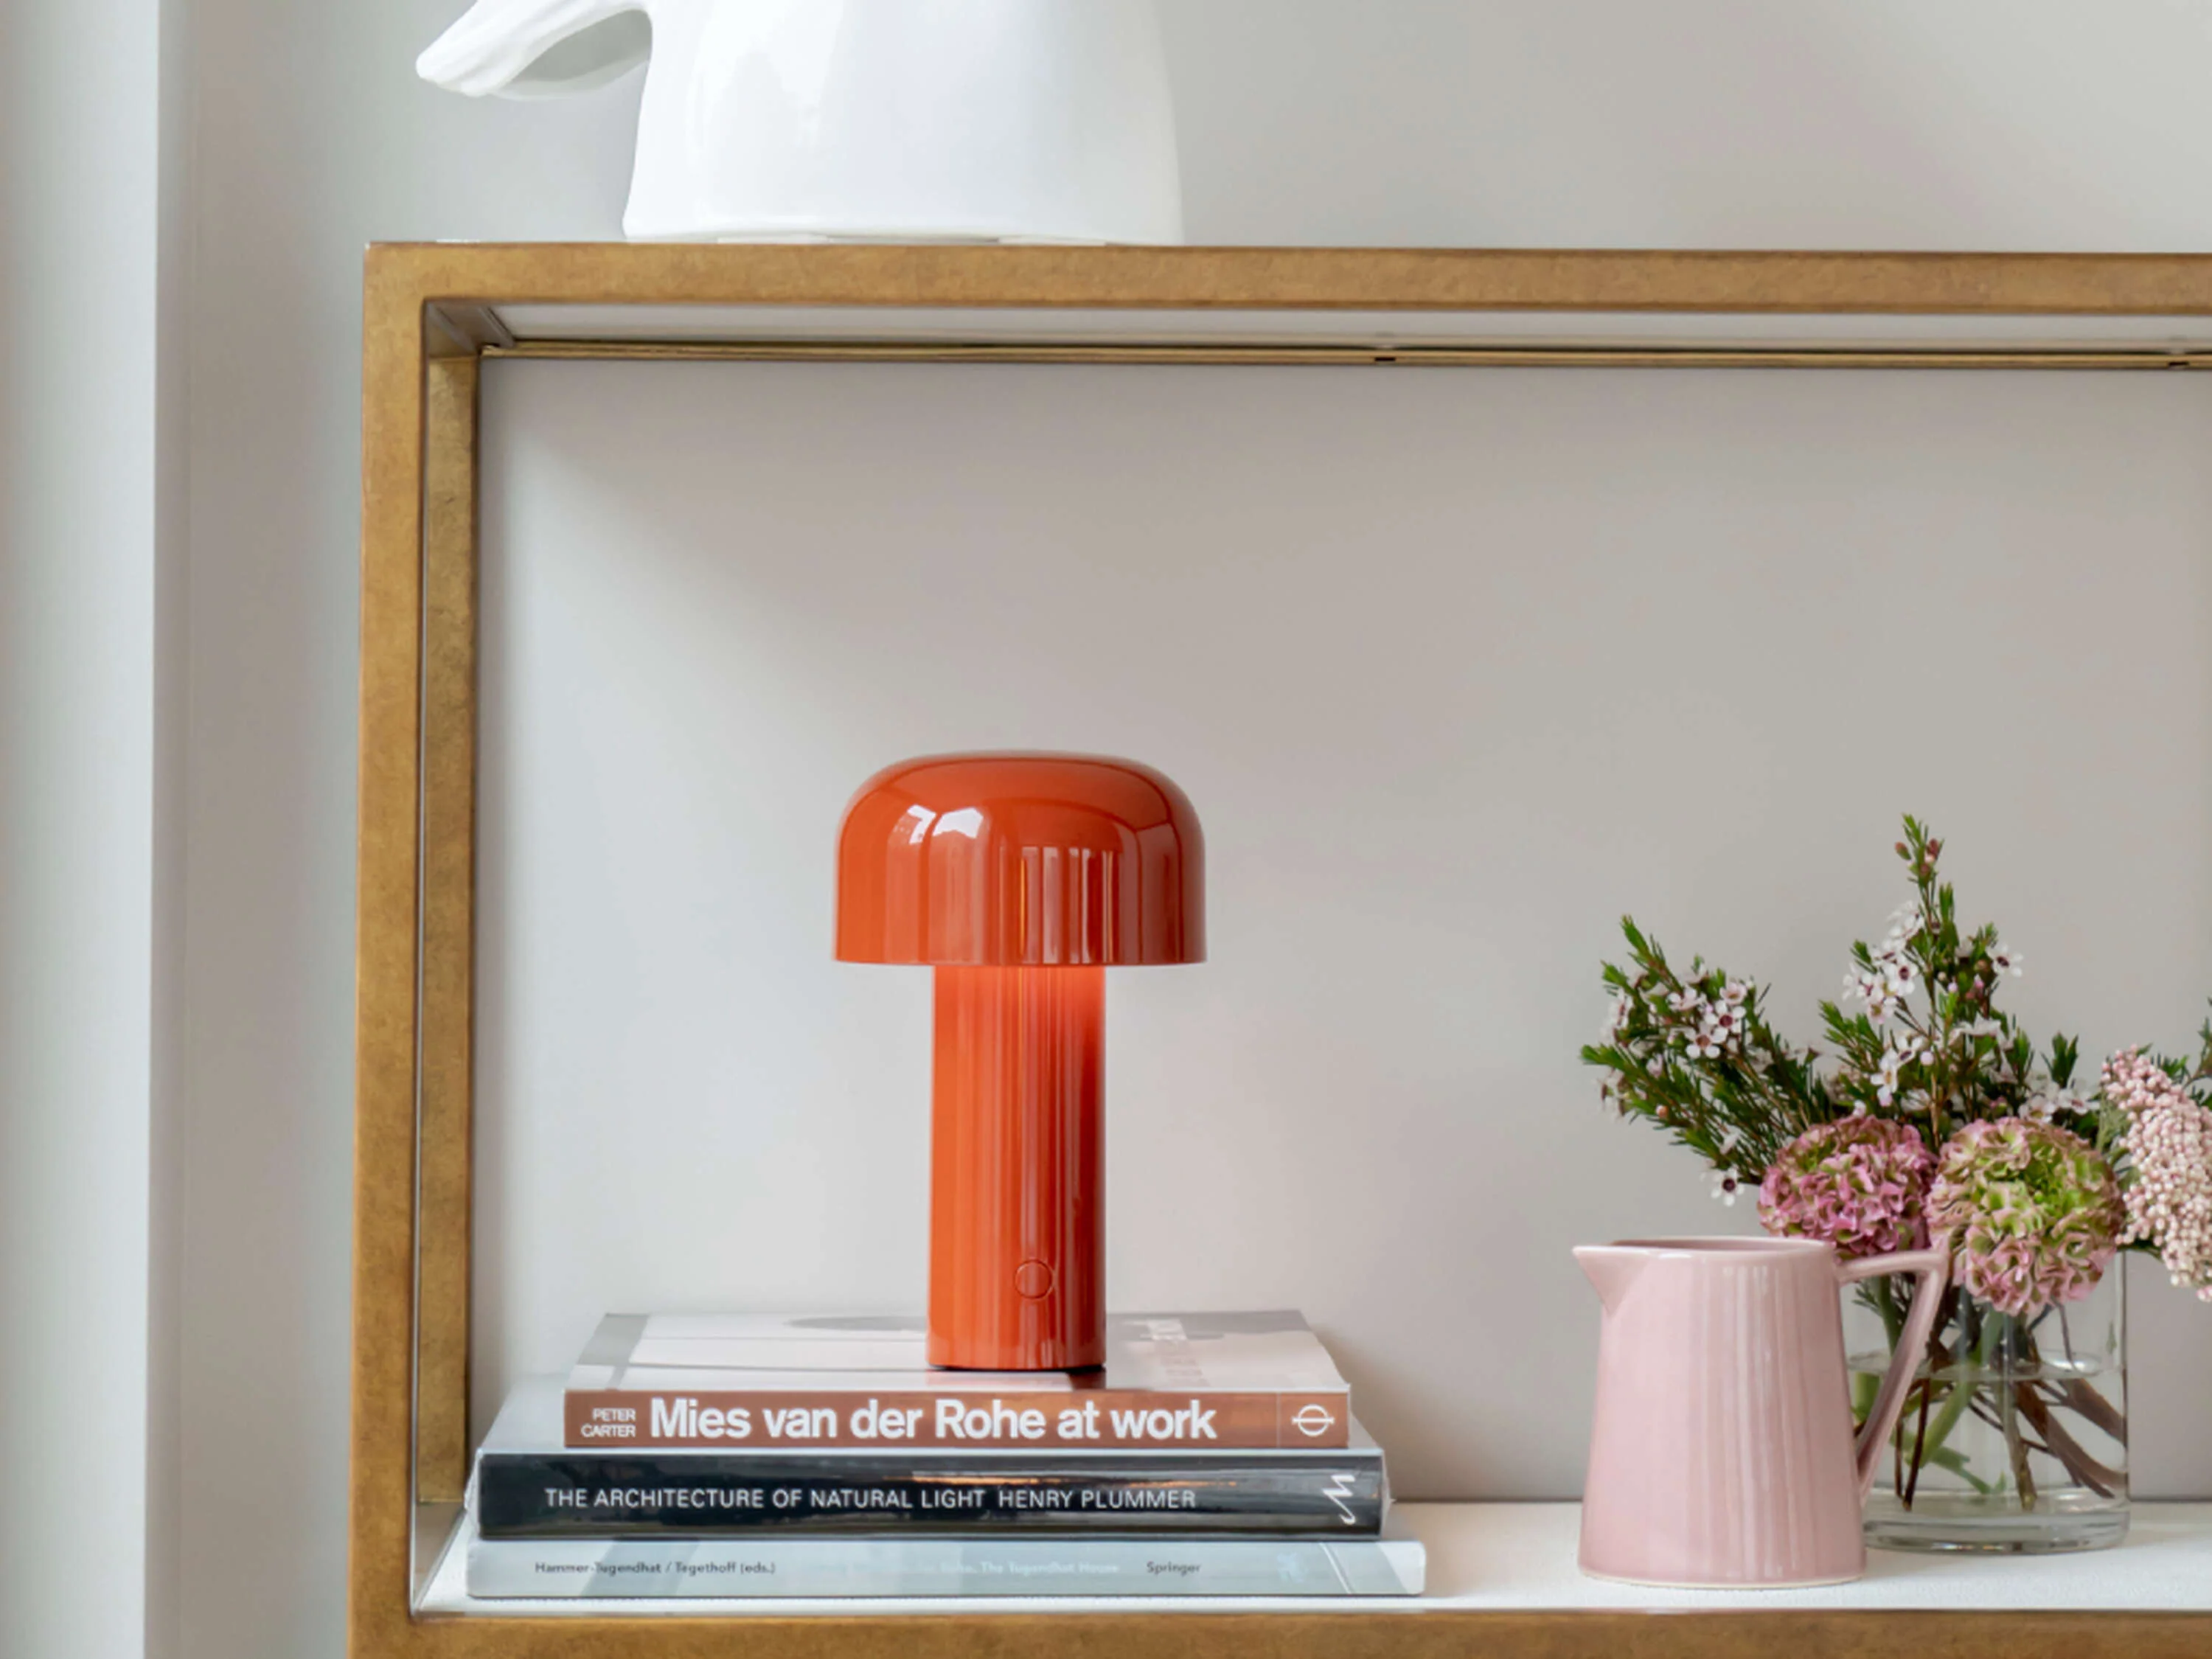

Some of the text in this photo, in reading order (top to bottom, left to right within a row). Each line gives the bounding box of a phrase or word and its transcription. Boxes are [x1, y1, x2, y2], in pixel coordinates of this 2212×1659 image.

[592, 1408, 636, 1422] PETER
[650, 1397, 1217, 1440] Mies van der Rohe at work
[580, 1424, 636, 1438] CARTER
[546, 1489, 1197, 1509] THE ARCHITECTURE OF NATURAL LIGHT HENRY PLUMMER
[675, 1561, 736, 1576] Tegethoff
[1147, 1561, 1201, 1576] Springer
